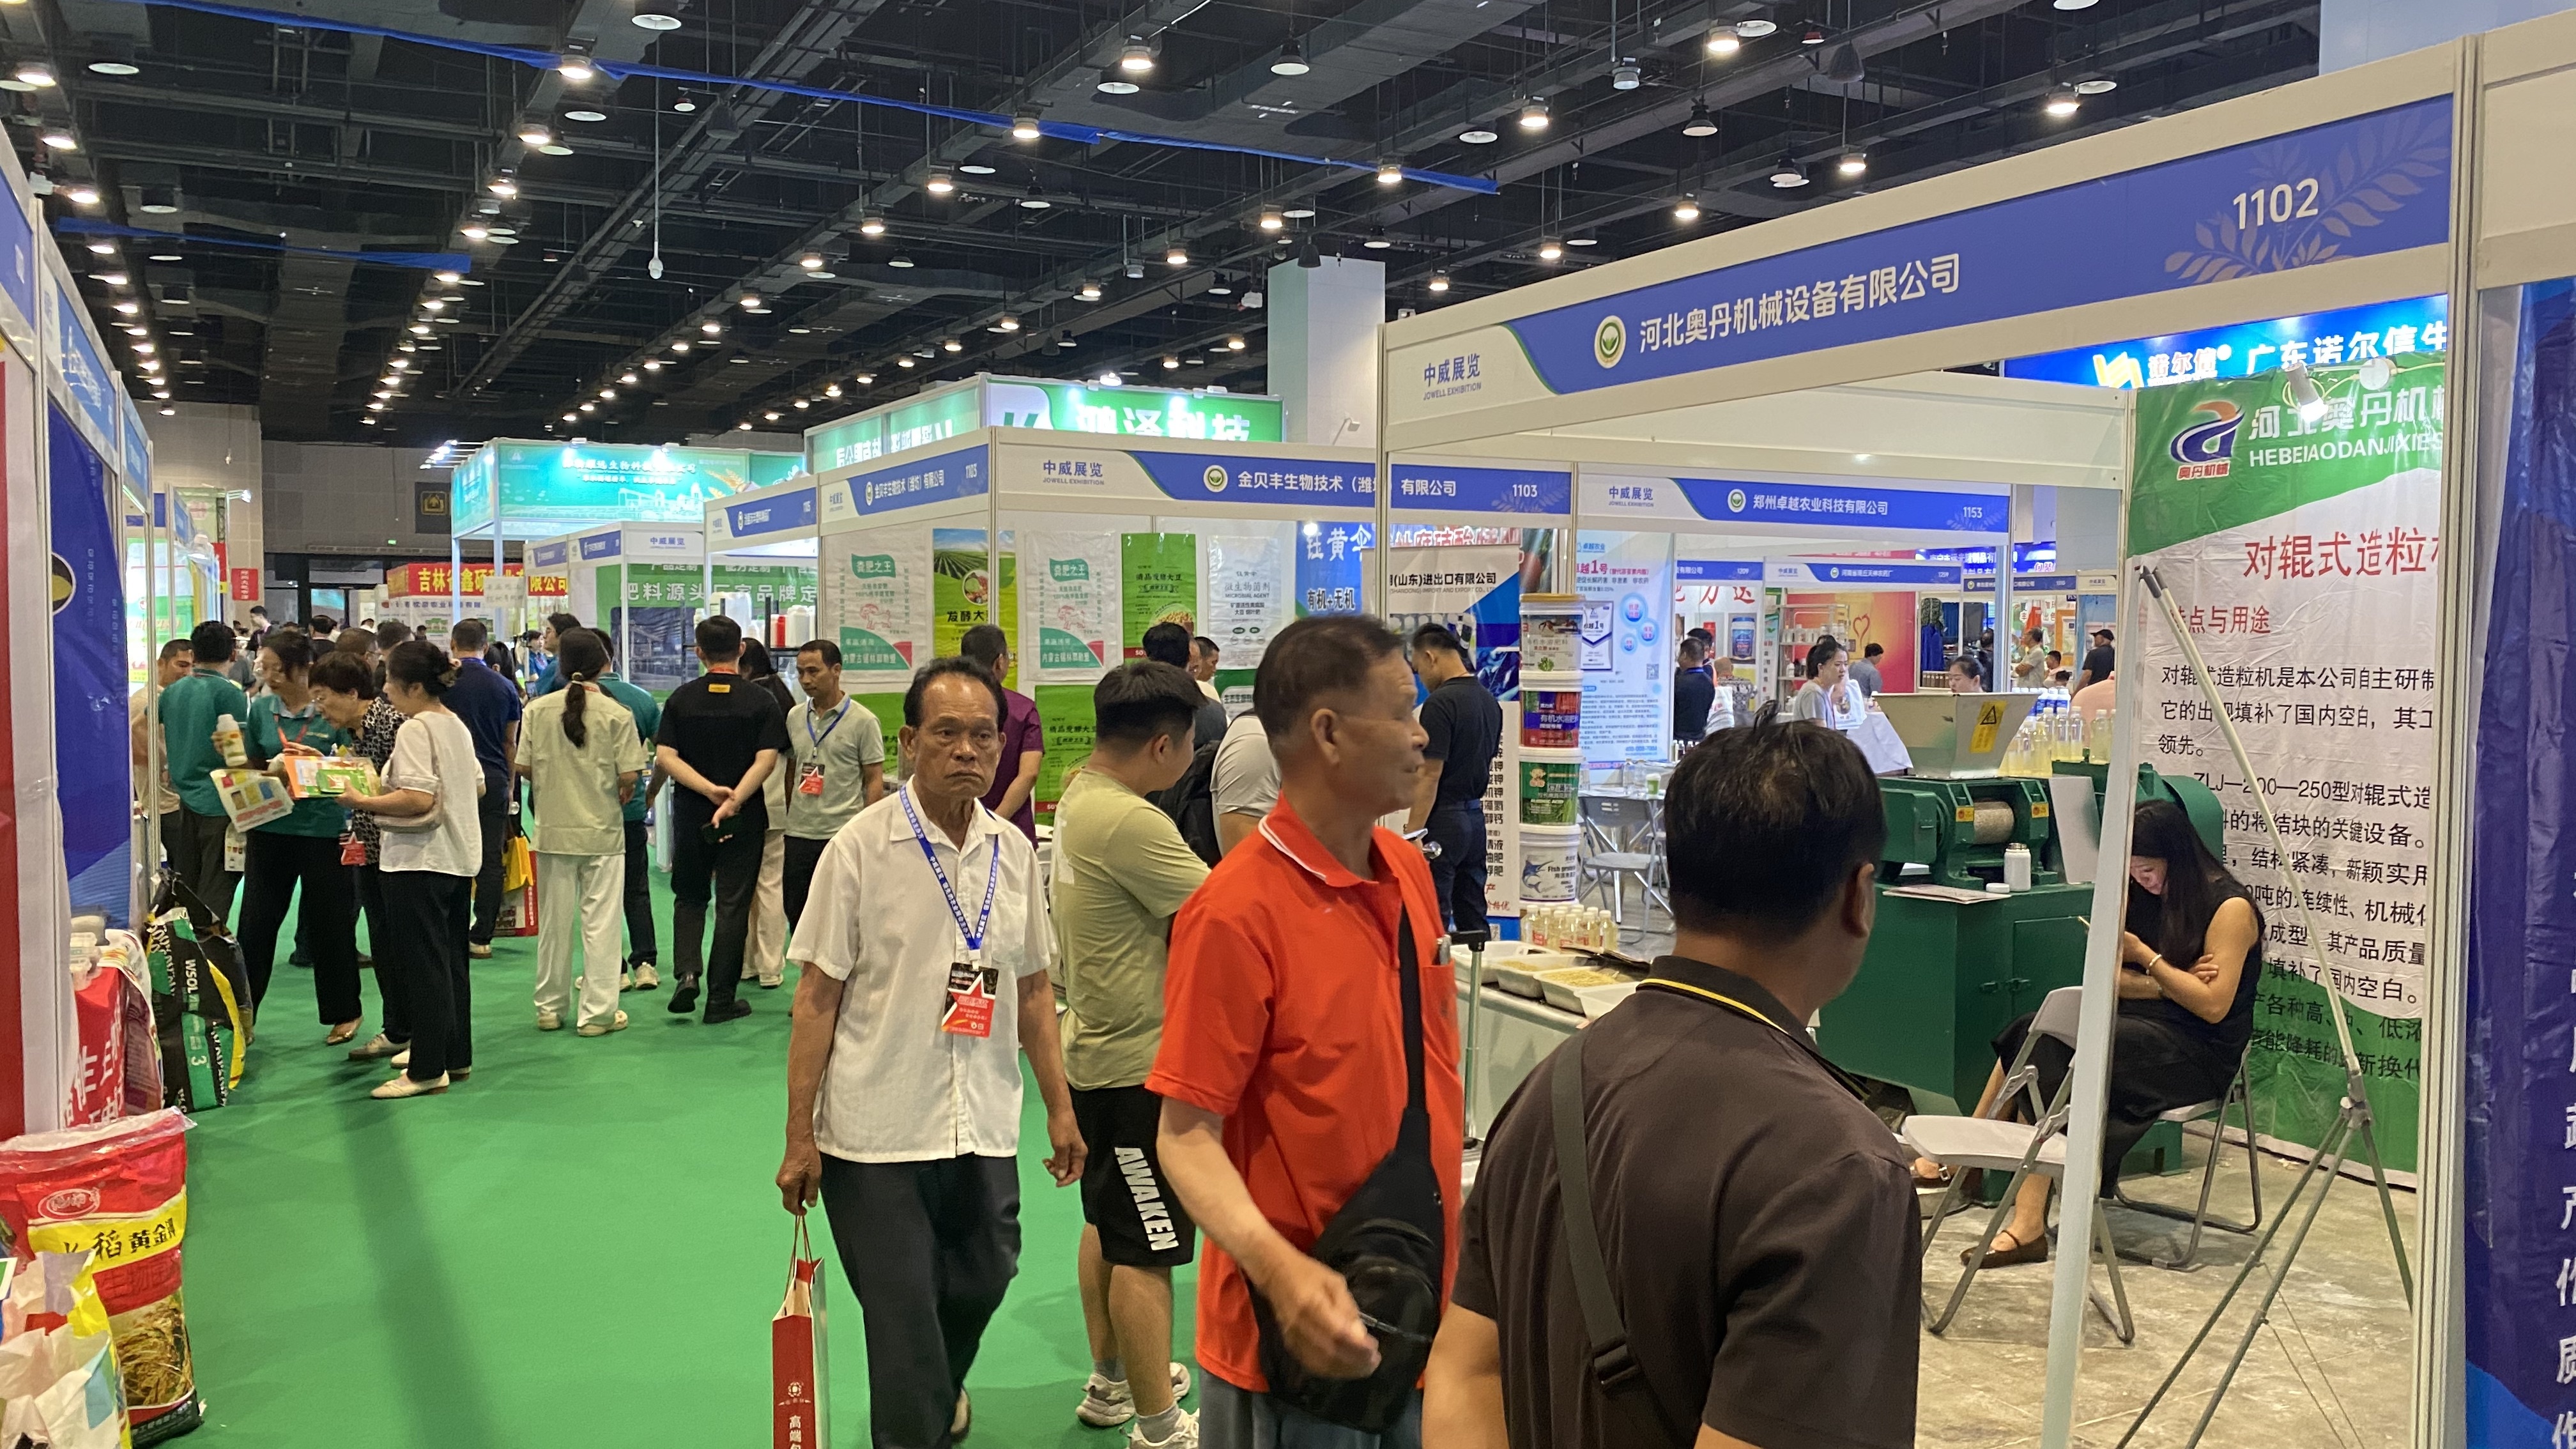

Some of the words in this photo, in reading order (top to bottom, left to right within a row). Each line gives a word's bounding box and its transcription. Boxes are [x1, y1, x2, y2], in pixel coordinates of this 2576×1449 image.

[2232, 178, 2319, 231] 1102
[1640, 253, 1960, 353] 河北奥丹机械设备有限公司
[1423, 353, 1481, 387] 中威展览
[1423, 388, 1446, 401] JOWELL
[1448, 382, 1482, 397] EXHIBITION
[1043, 460, 1103, 477] 中威展览
[2177, 461, 2230, 481] 奥丹机械
[1512, 483, 1538, 498] 1103
[1608, 486, 1653, 502] 中威展览
[1753, 494, 1888, 516] 郑州卓越农业科技有限公司
[1963, 506, 1983, 519] 1153
[650, 537, 686, 546] 中威展览
[1225, 581, 1270, 592] 微生物菌剂
[1307, 587, 1355, 611] 有机+无机
[947, 611, 988, 622] 发酵大
[2158, 734, 2204, 756] 领先。
[1115, 1147, 1180, 1253] AWAKEN
